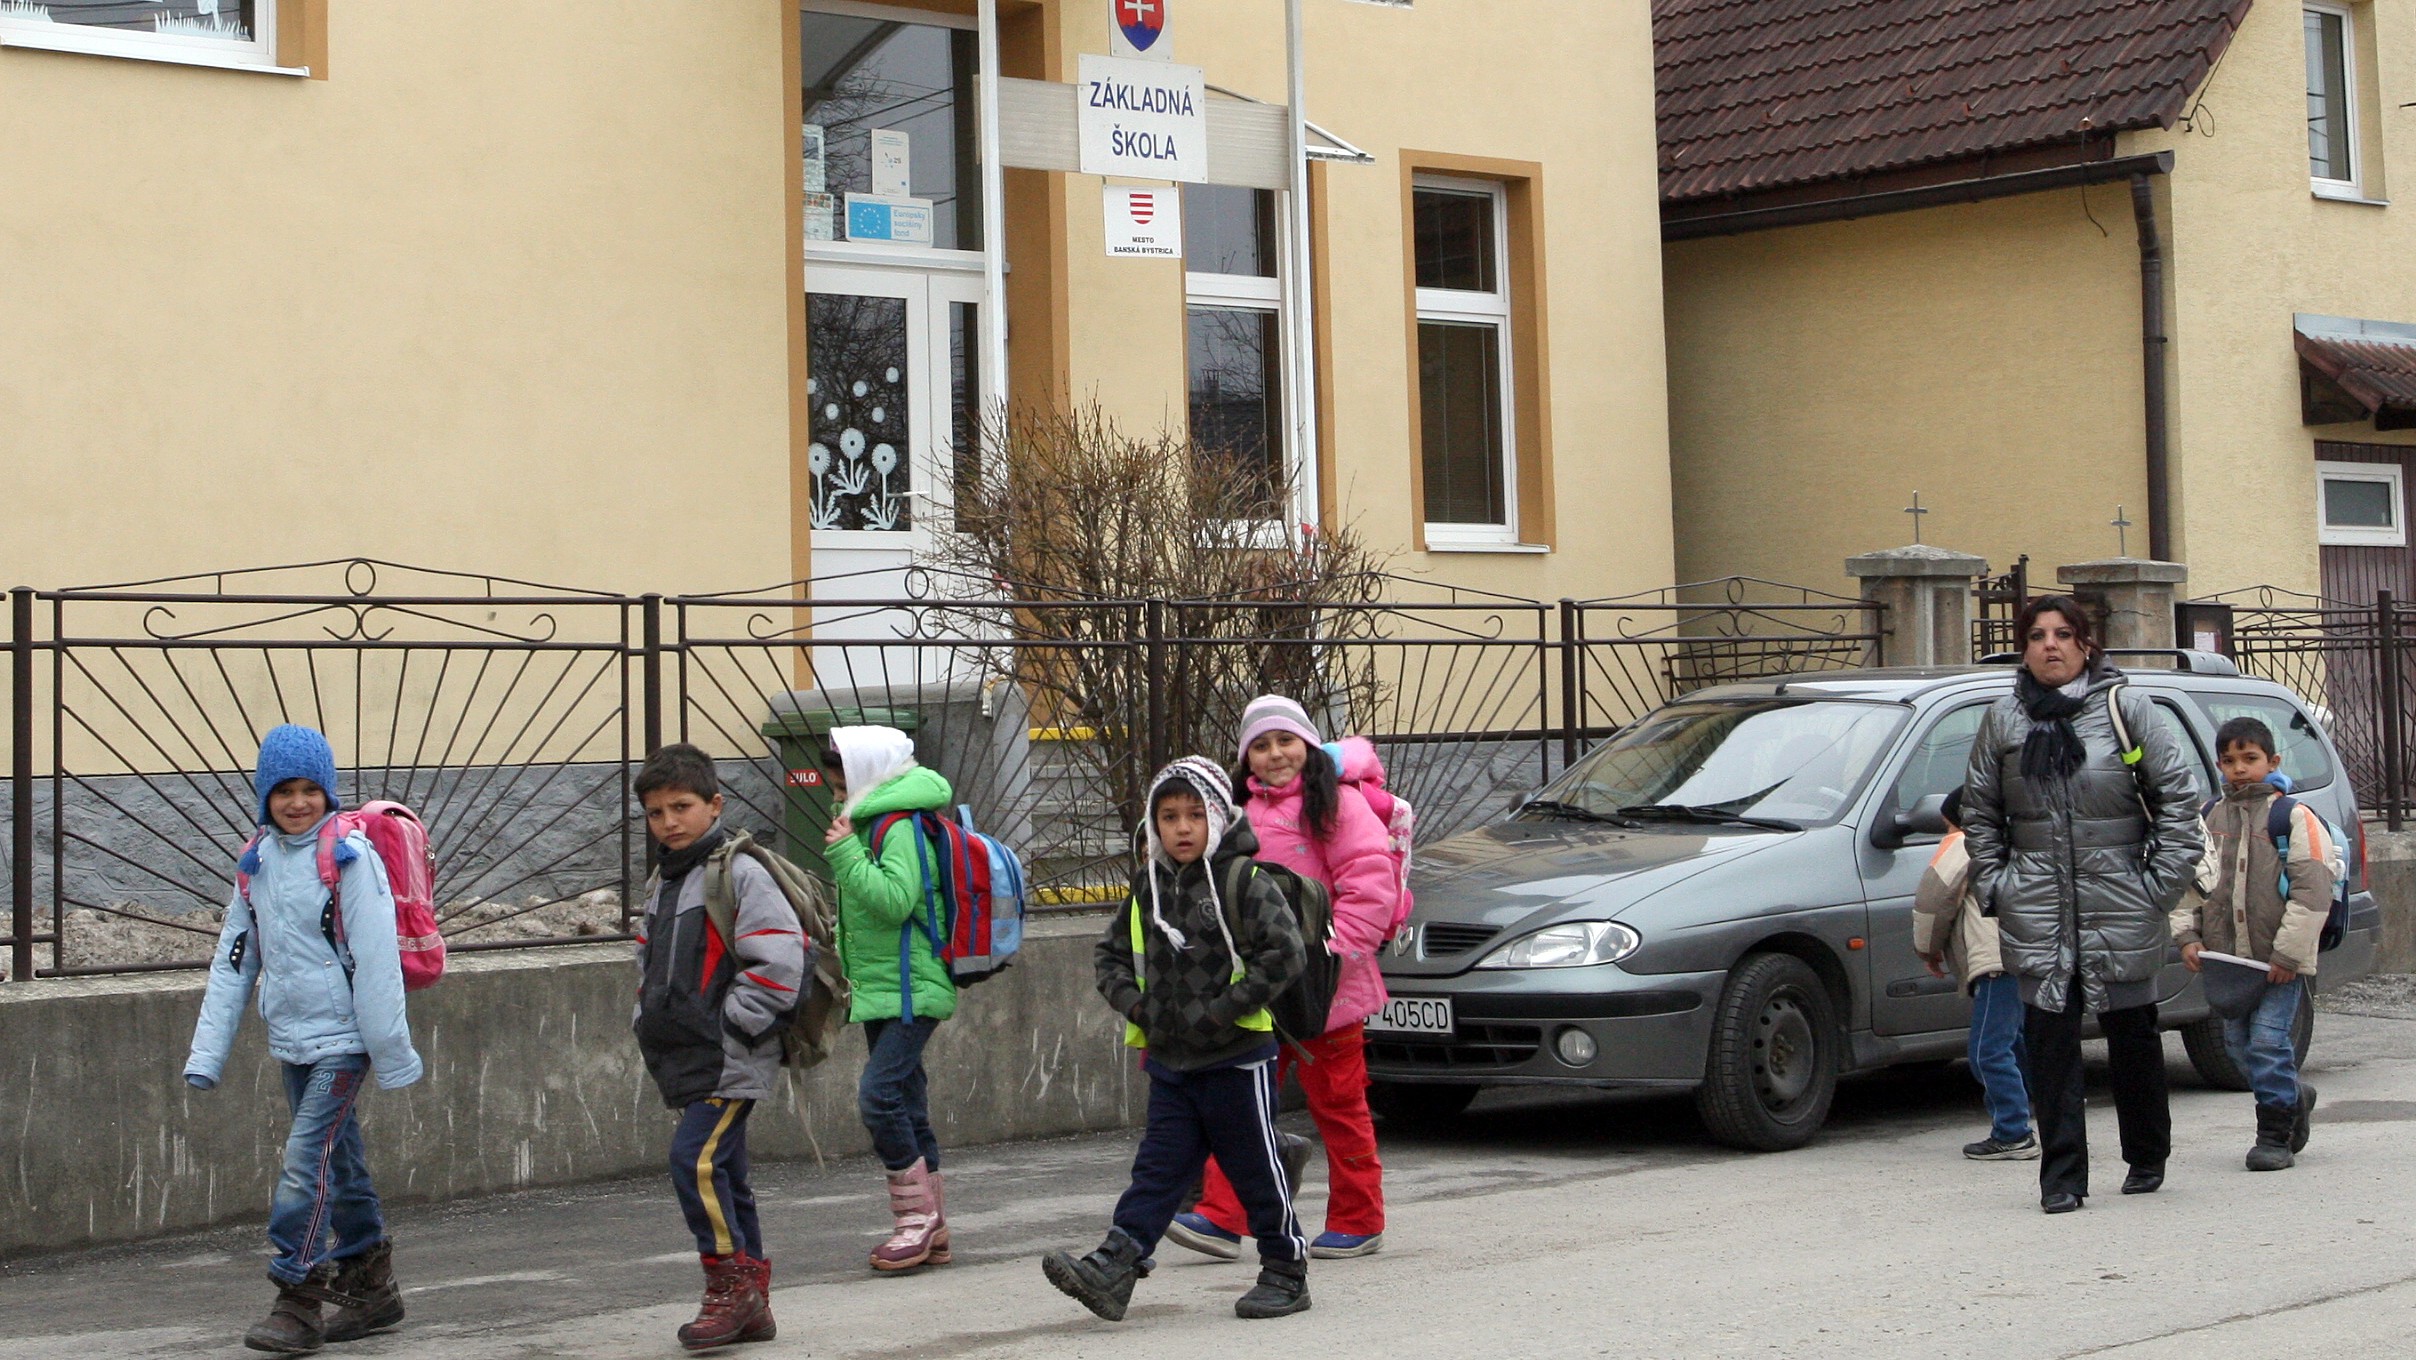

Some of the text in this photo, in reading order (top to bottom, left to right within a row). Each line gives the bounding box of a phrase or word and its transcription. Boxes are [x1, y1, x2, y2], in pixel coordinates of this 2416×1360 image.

[1090, 77, 1194, 117] ZÁKLADNÁ
[1112, 123, 1178, 161] ŠKOLA
[1142, 247, 1173, 255] BYSTRICA
